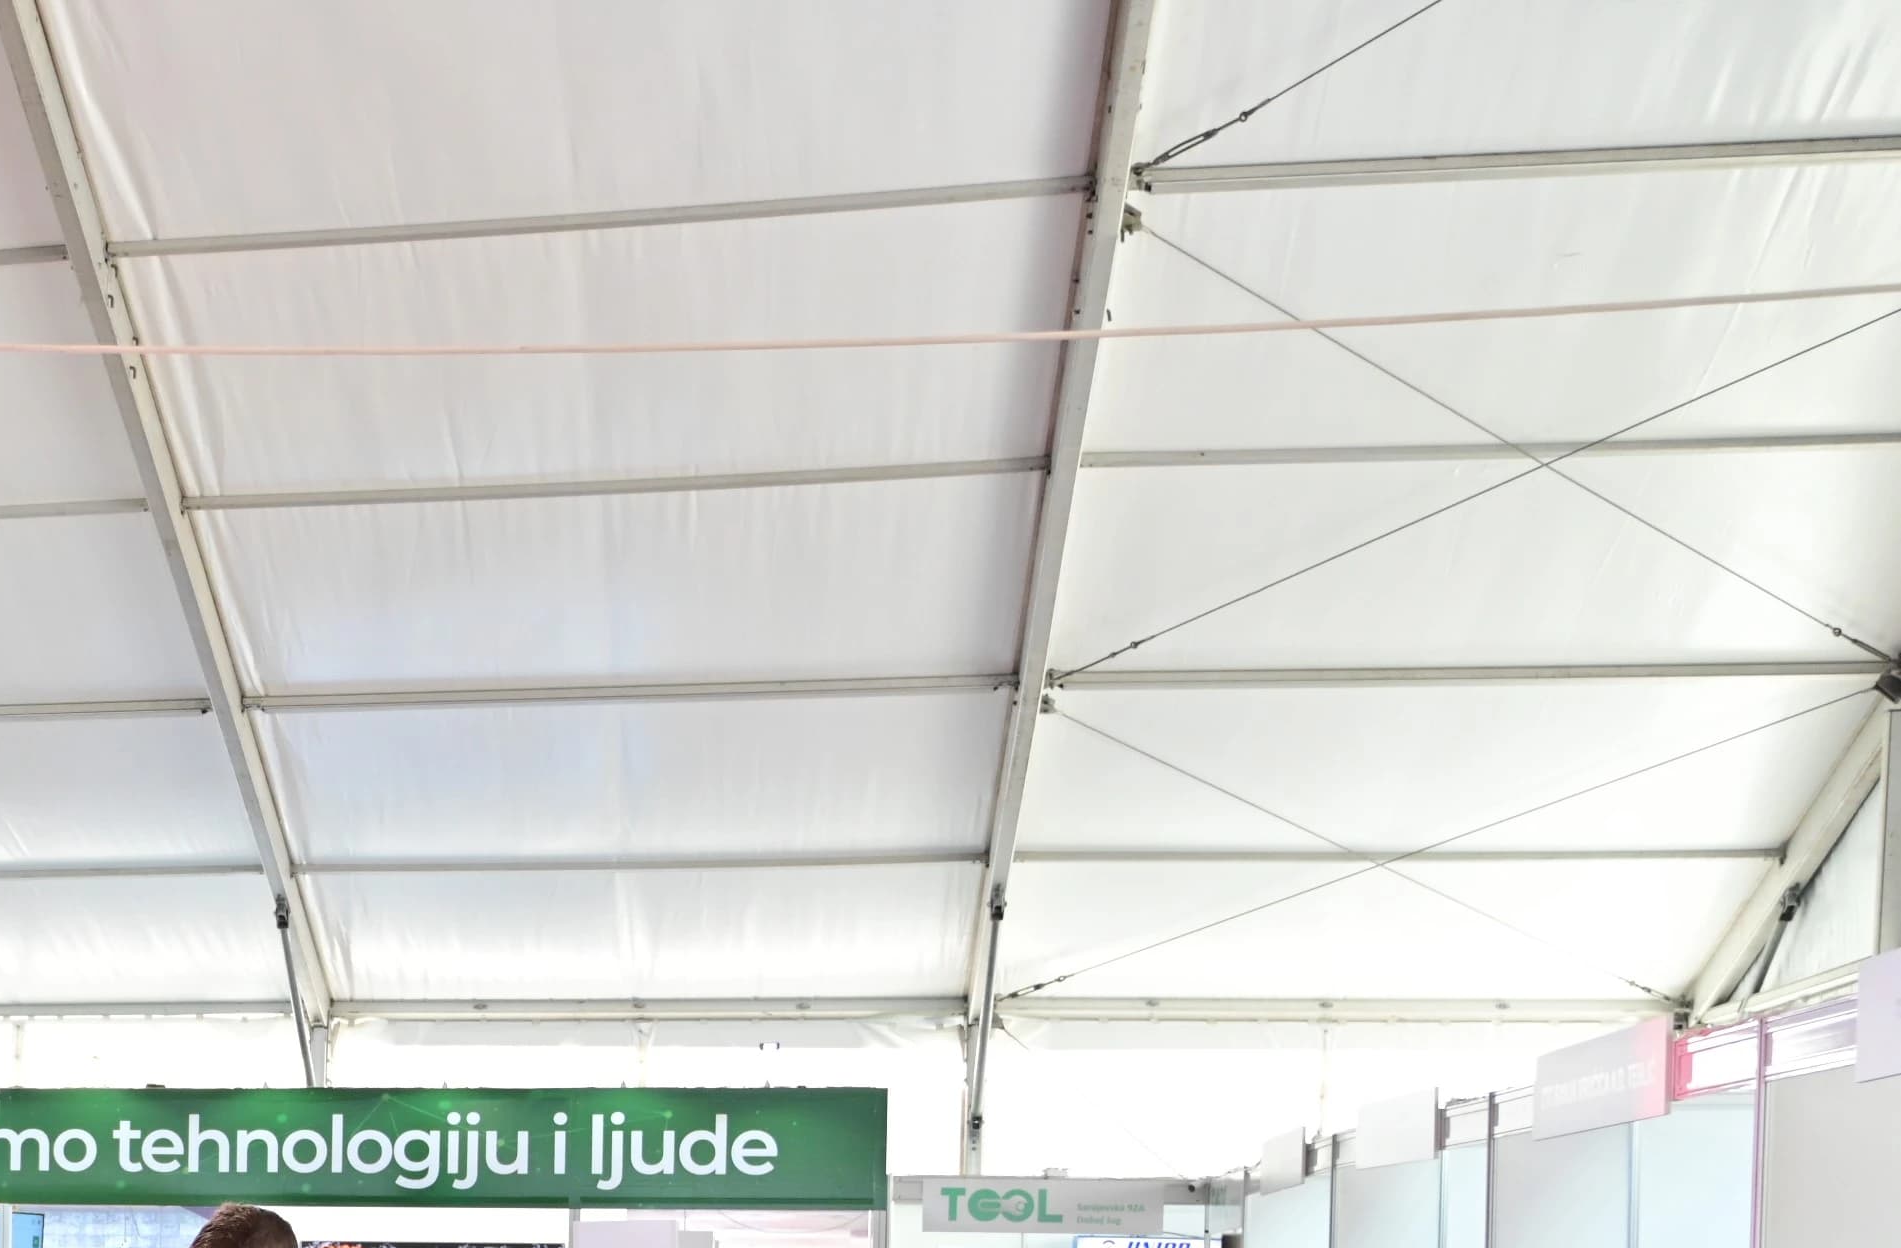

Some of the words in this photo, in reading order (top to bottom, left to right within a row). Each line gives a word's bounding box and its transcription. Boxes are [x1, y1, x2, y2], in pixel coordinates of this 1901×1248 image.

[112, 1112, 529, 1190] tehnologiju
[553, 1111, 569, 1175] i
[591, 1111, 779, 1190] ljude
[940, 1187, 1063, 1223] TOOL
